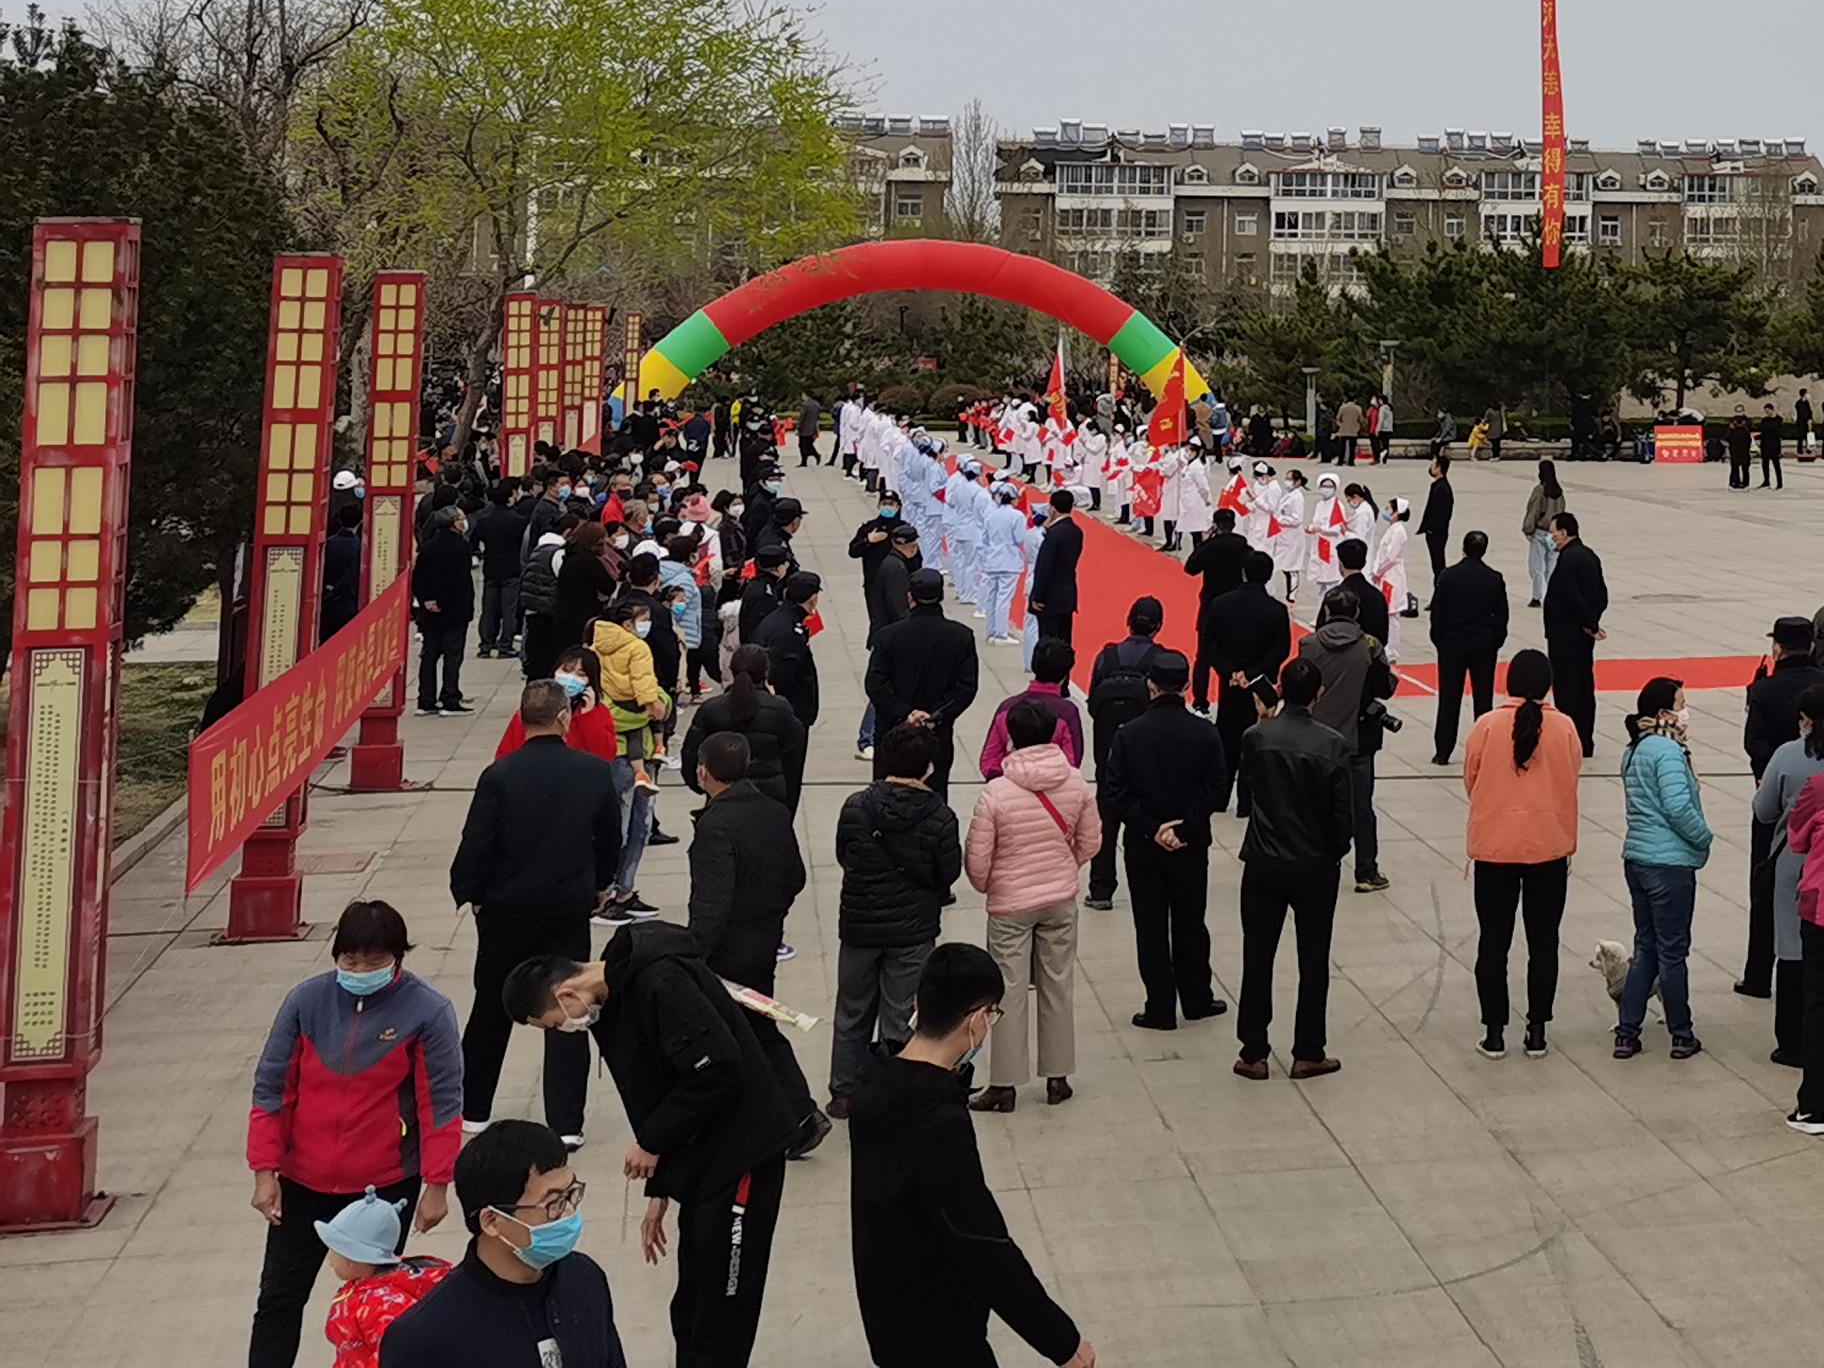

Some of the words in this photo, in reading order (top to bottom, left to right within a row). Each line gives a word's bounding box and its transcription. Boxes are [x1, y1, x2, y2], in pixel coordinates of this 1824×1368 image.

[208, 669, 327, 853] 用初心点亮生命
